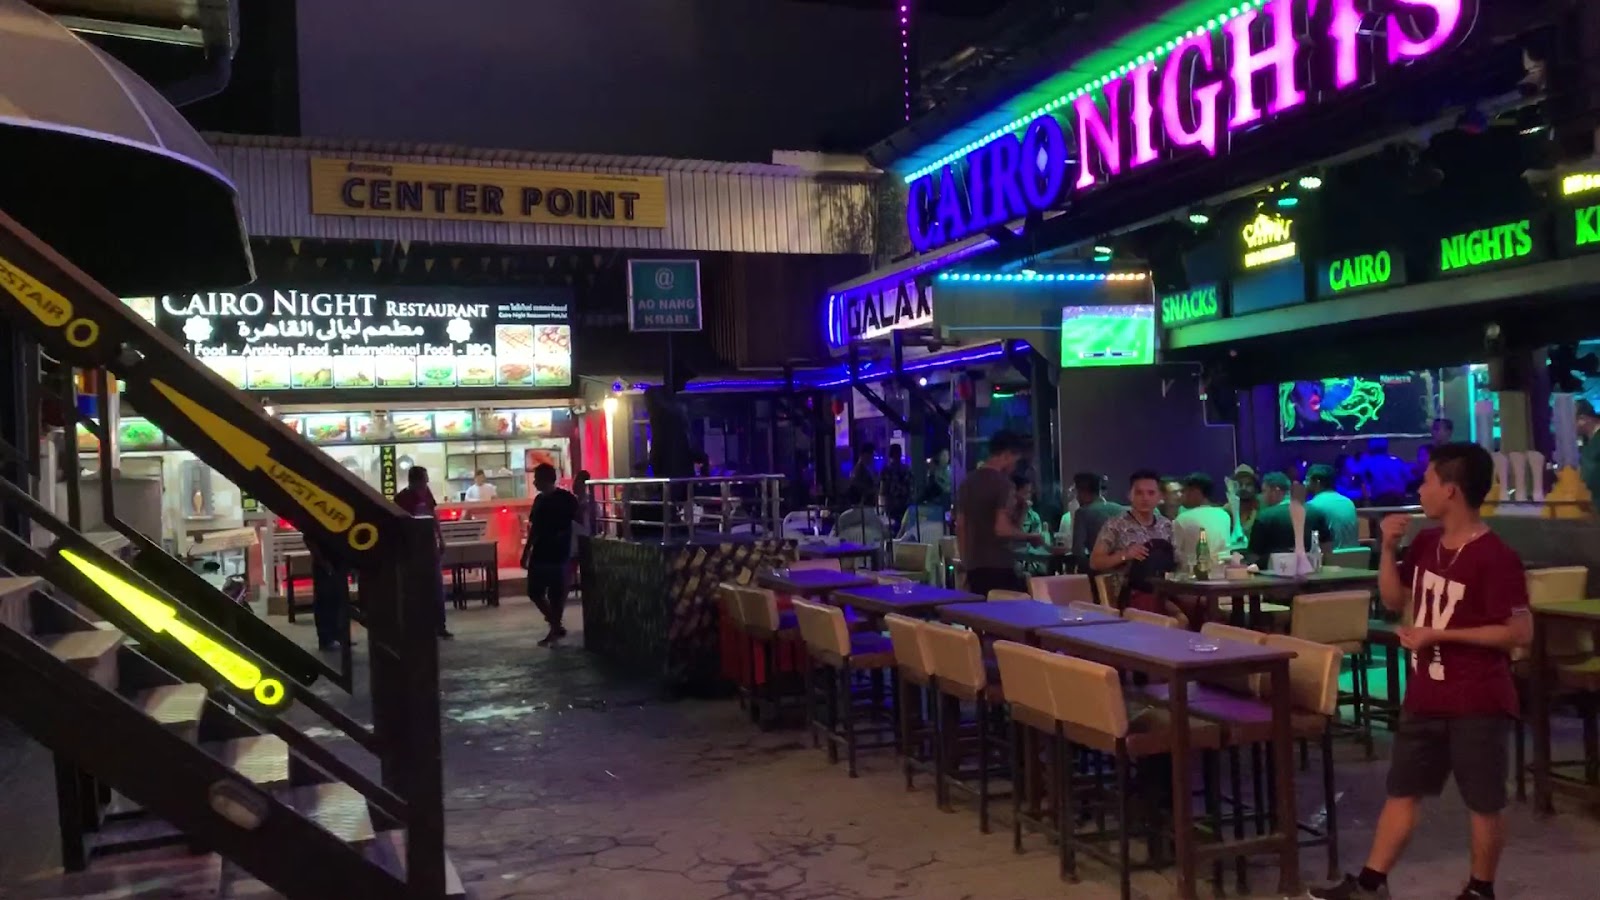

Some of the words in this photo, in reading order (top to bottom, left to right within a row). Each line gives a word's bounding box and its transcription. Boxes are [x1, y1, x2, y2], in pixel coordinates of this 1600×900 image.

[907, 114, 1067, 254] CAIRO
[1073, 0, 1462, 190] NIGHTS
[342, 177, 504, 215] CENTER
[521, 187, 640, 220] POINT
[1441, 220, 1532, 271] NIGHTS
[1329, 250, 1391, 292] CAIRO
[161, 291, 264, 316] CAIRO
[272, 289, 377, 316] NIGHT
[386, 301, 489, 318] RESTAURANT
[638, 299, 655, 310] AO
[659, 299, 696, 310] NANG
[645, 314, 690, 325] KRABI
[1161, 287, 1218, 322] SNACKS
[237, 319, 314, 343] القاهرة
[362, 318, 425, 344] مطعم
[194, 343, 227, 356] Food
[242, 343, 294, 356] Arabian
[297, 343, 329, 356] Food
[343, 343, 420, 356] International
[423, 343, 453, 356] Food
[269, 464, 348, 526] UPSTAIR
